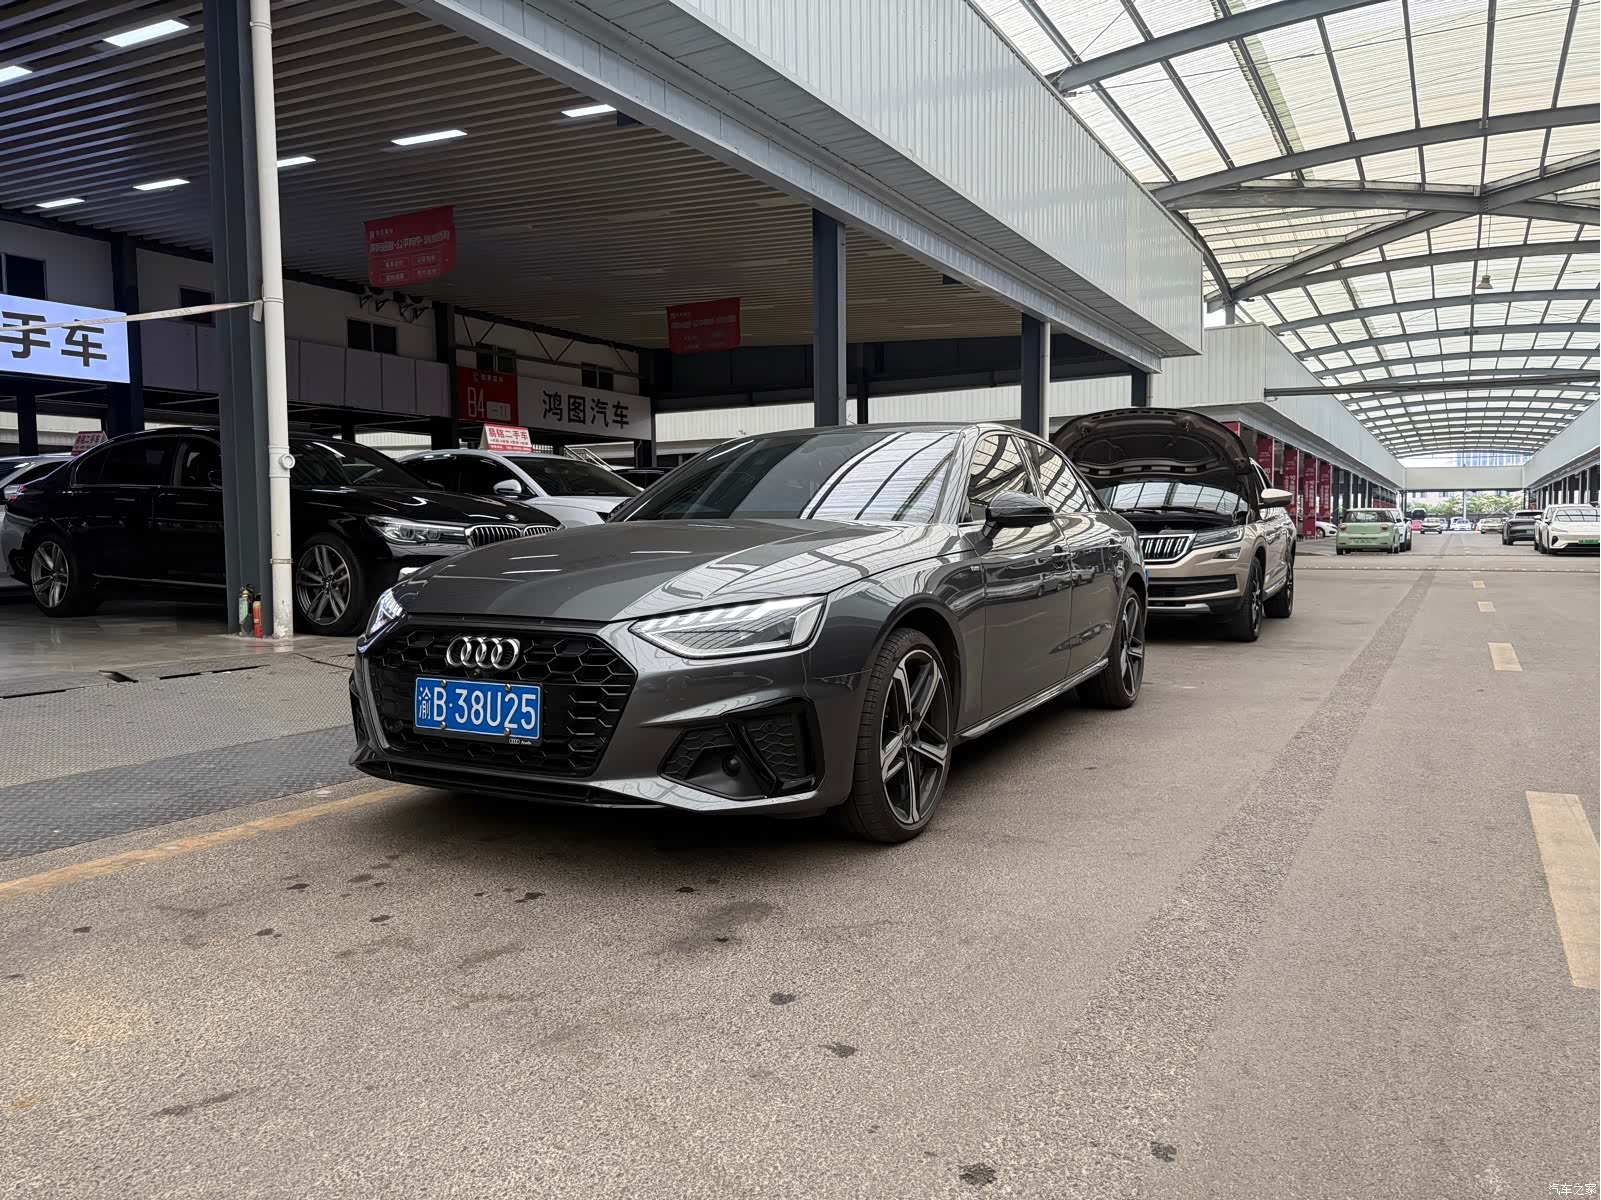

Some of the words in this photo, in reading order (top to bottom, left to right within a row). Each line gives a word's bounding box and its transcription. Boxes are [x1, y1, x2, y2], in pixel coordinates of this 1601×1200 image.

[541, 390, 630, 430] 鸿图汽车
[418, 686, 537, 730] 渝B·38U25
